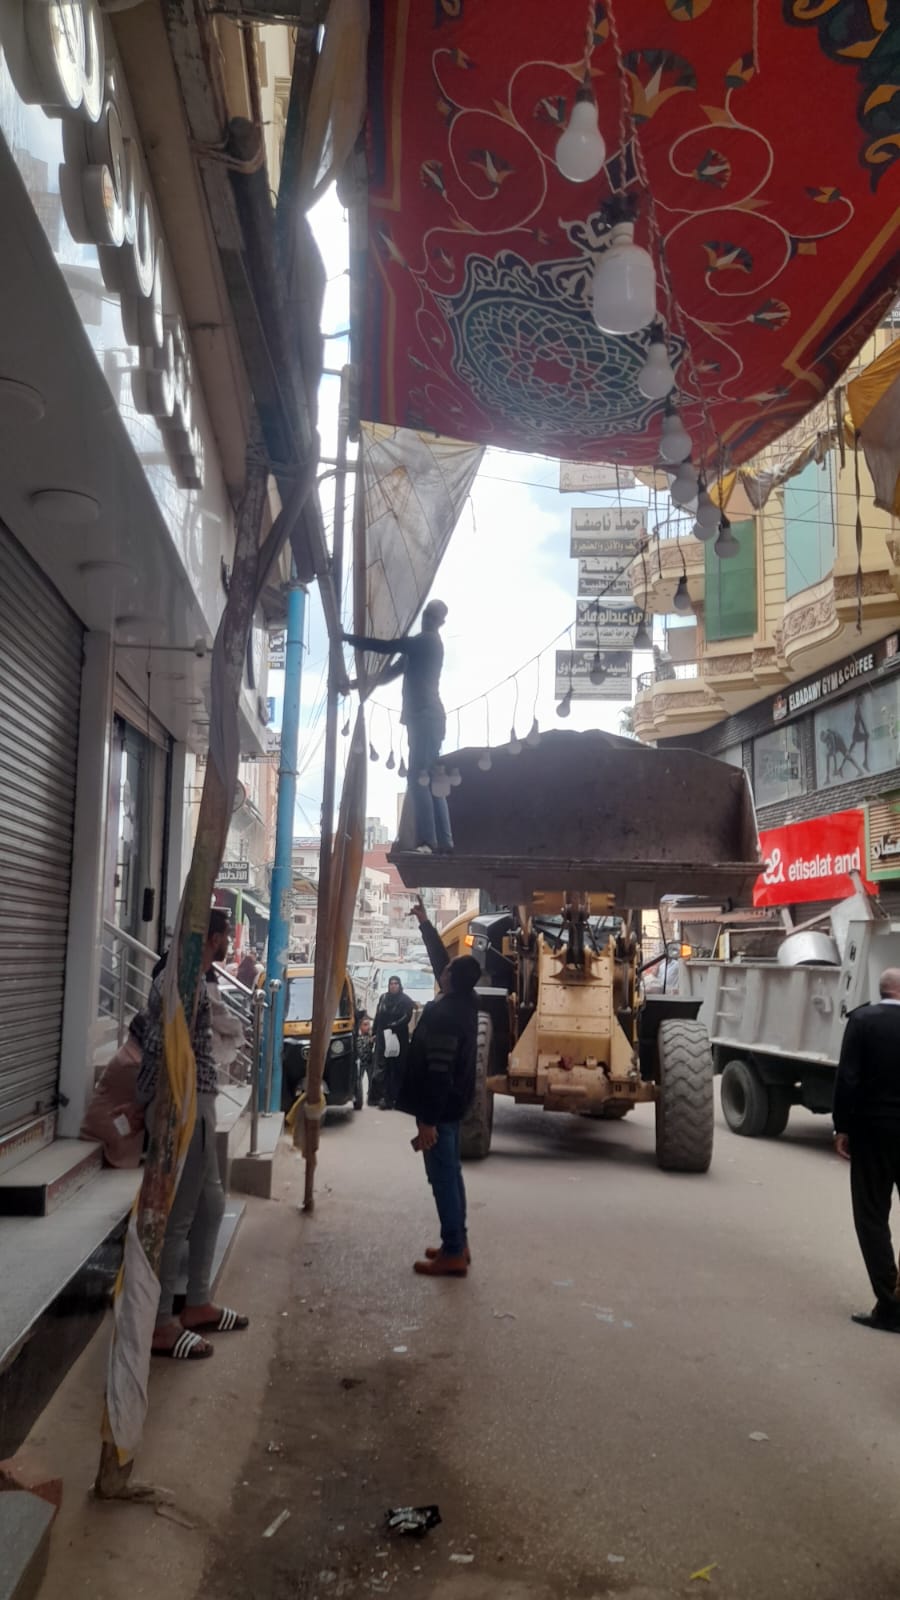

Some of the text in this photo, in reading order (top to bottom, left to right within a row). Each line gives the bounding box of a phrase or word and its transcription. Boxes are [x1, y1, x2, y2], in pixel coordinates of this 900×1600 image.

[789, 680, 822, 711] ELBADAWY
[788, 854, 833, 882] etisalat
[834, 846, 860, 875] and
